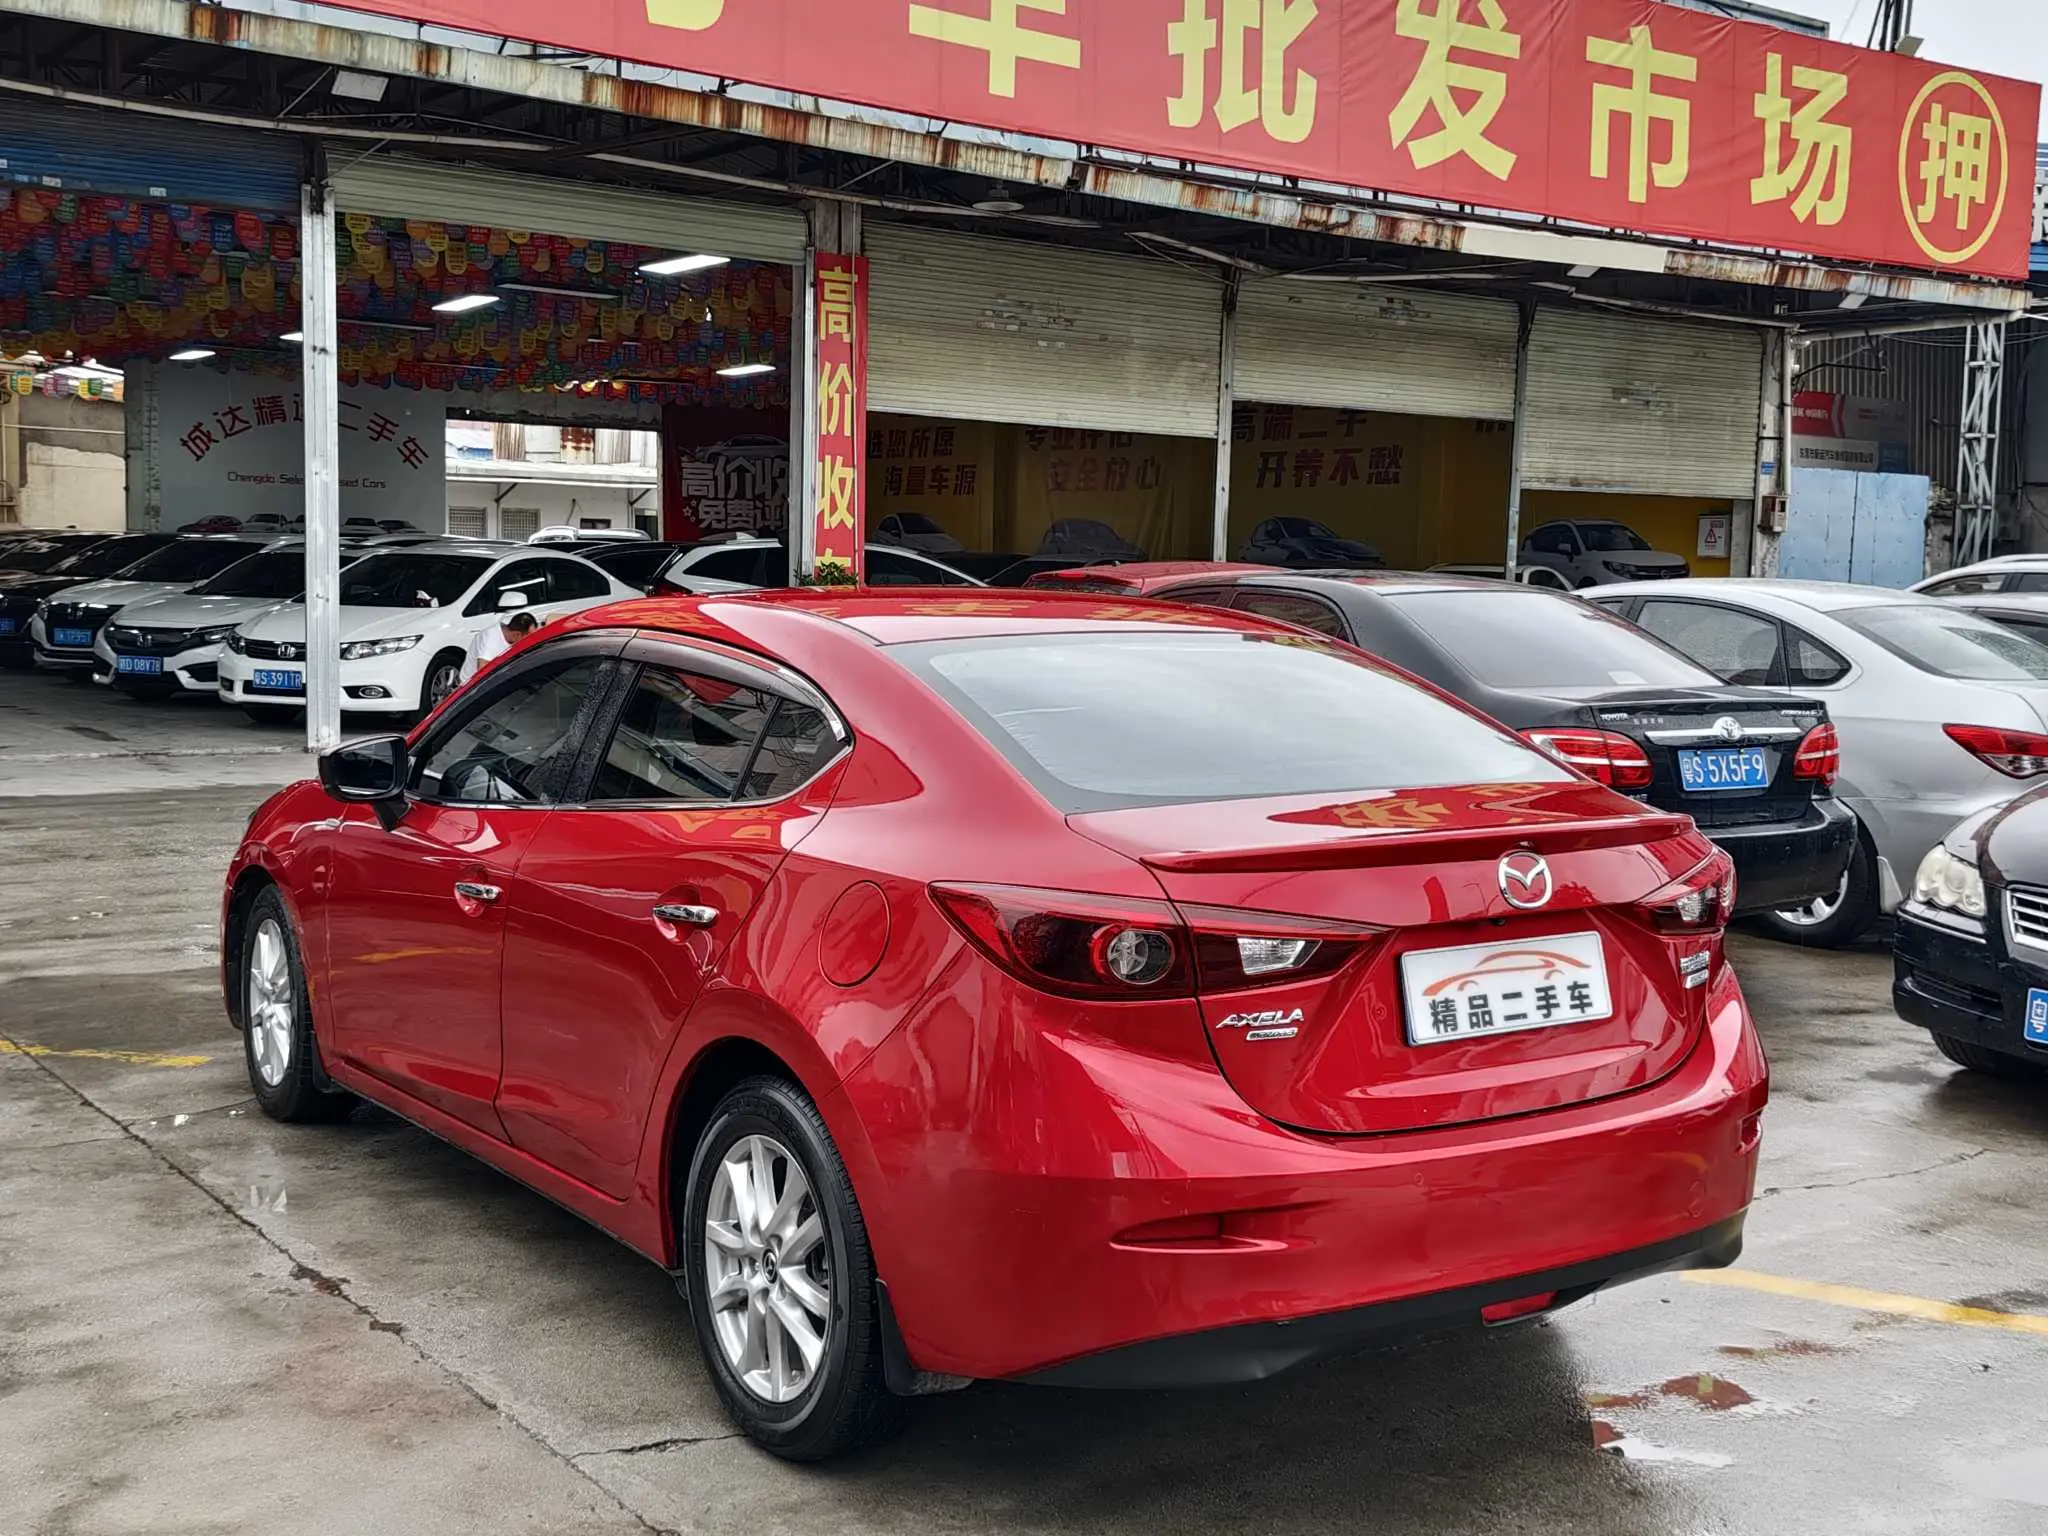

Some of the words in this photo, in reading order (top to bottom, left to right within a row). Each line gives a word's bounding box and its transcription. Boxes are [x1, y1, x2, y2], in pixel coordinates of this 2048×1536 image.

[643, 0, 1852, 226] 批发市场
[1916, 102, 1992, 230] 押
[816, 265, 856, 567] 高价收
[884, 463, 977, 496] 海量车源
[1257, 444, 1403, 488] 开养不愁
[699, 499, 788, 530] 免费评
[1215, 1008, 1304, 1029] AXELA
[1429, 980, 1593, 1034] 精品二手车
